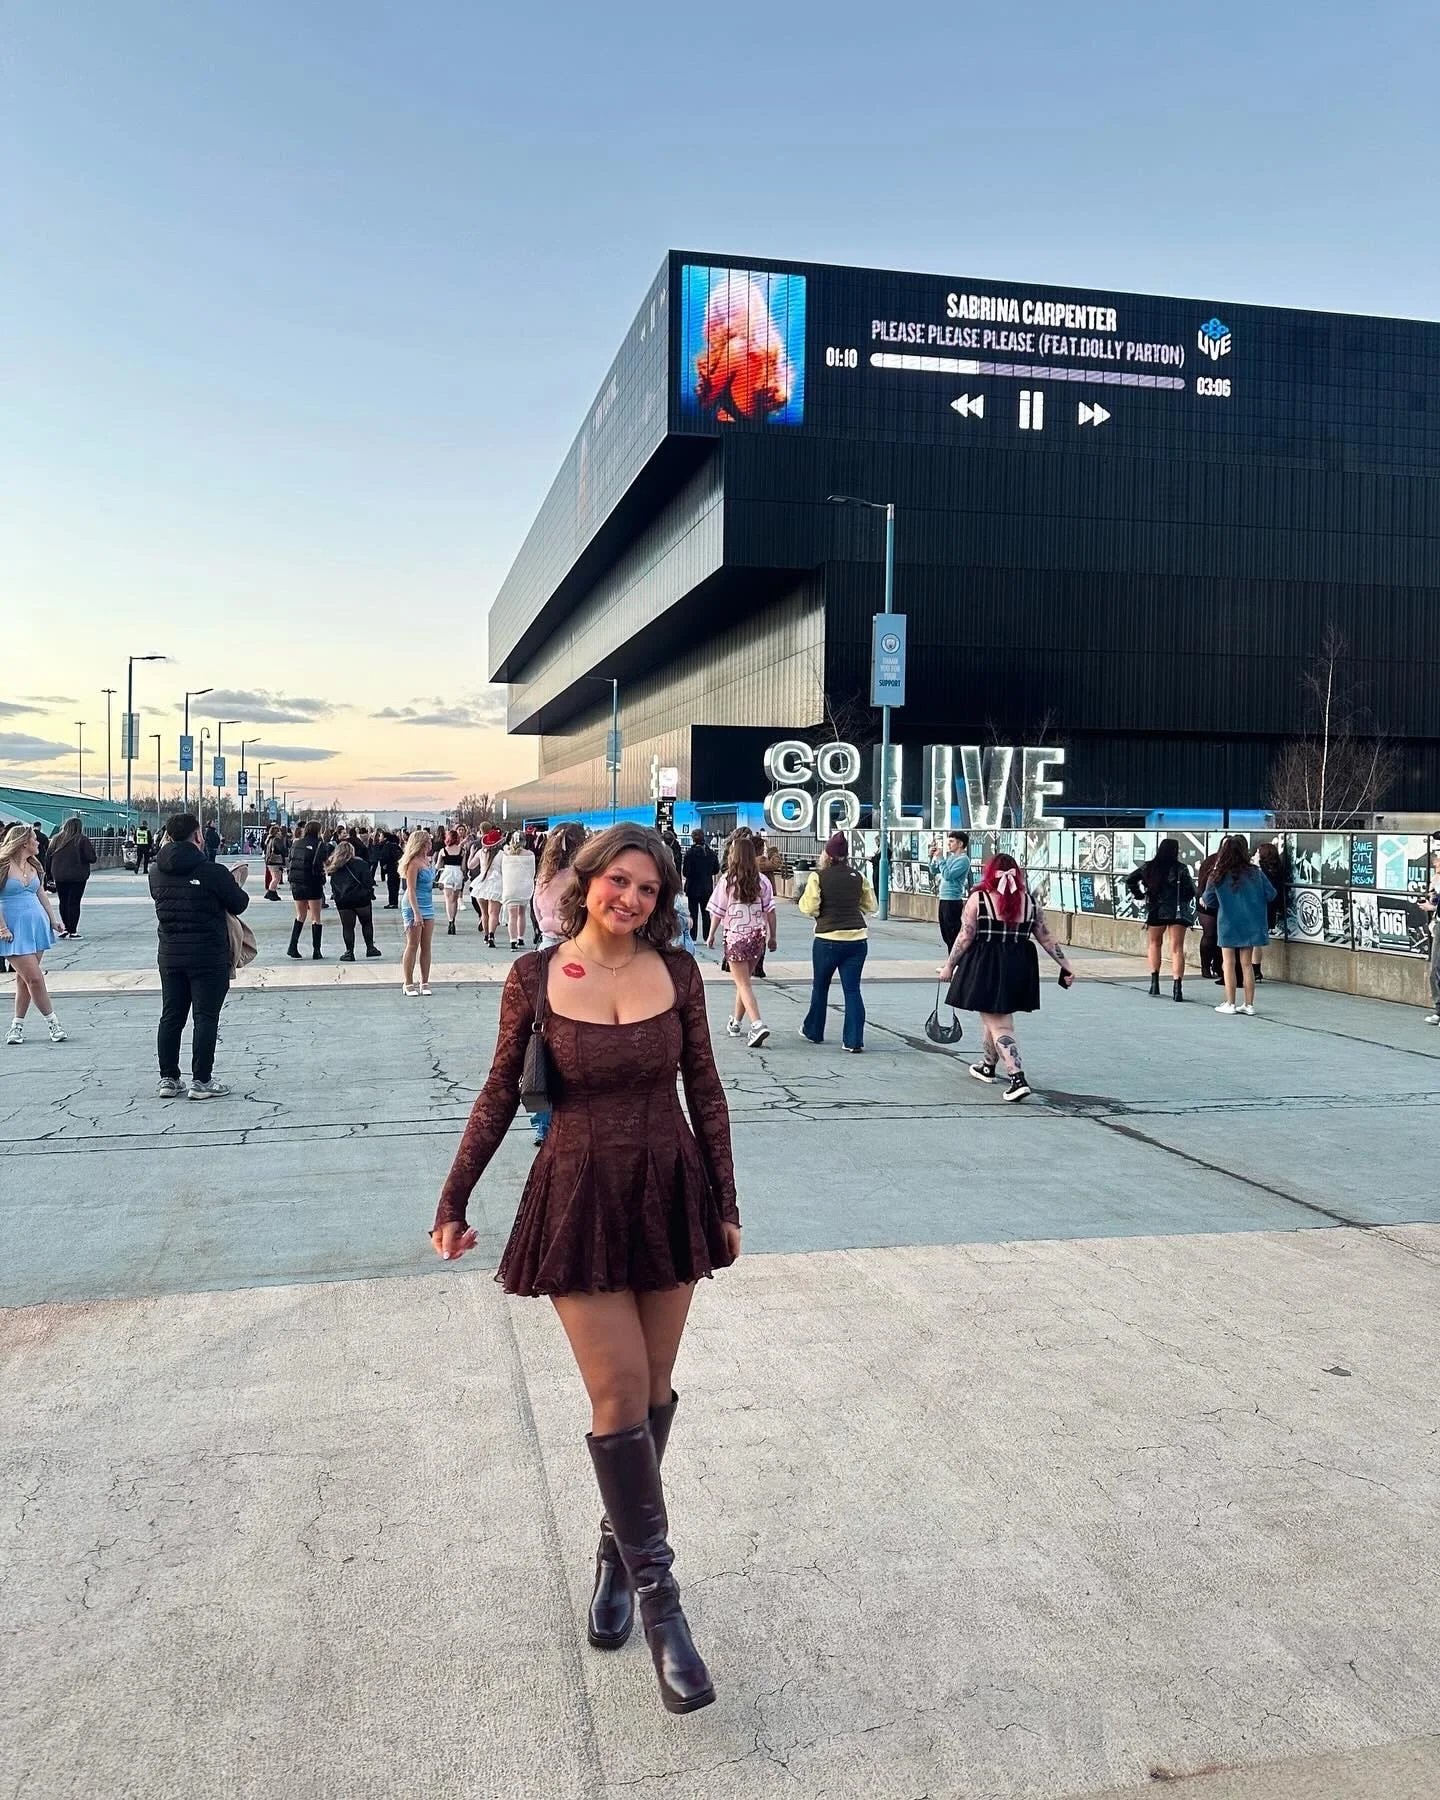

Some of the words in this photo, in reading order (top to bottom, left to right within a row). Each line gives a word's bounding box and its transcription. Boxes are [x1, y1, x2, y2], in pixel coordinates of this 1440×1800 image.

[946, 292, 1020, 324] SABRINA
[1022, 299, 1118, 332] CARPENTER
[871, 319, 926, 344] PLEASE
[927, 324, 981, 348] PLEASE
[983, 329, 1036, 353] PLEASE
[1038, 332, 1125, 360] (FEAT.DOLLY
[1126, 341, 1186, 369] PARTON)
[825, 346, 858, 369] 01:10
[1196, 376, 1232, 398] 03:06
[879, 679, 901, 687] SUPPORT
[874, 744, 1065, 830] LIVE
[1352, 842, 1374, 852] SAME
[1352, 852, 1372, 864] CITY
[1352, 864, 1374, 874] SAME
[1380, 911, 1407, 937] 0161
